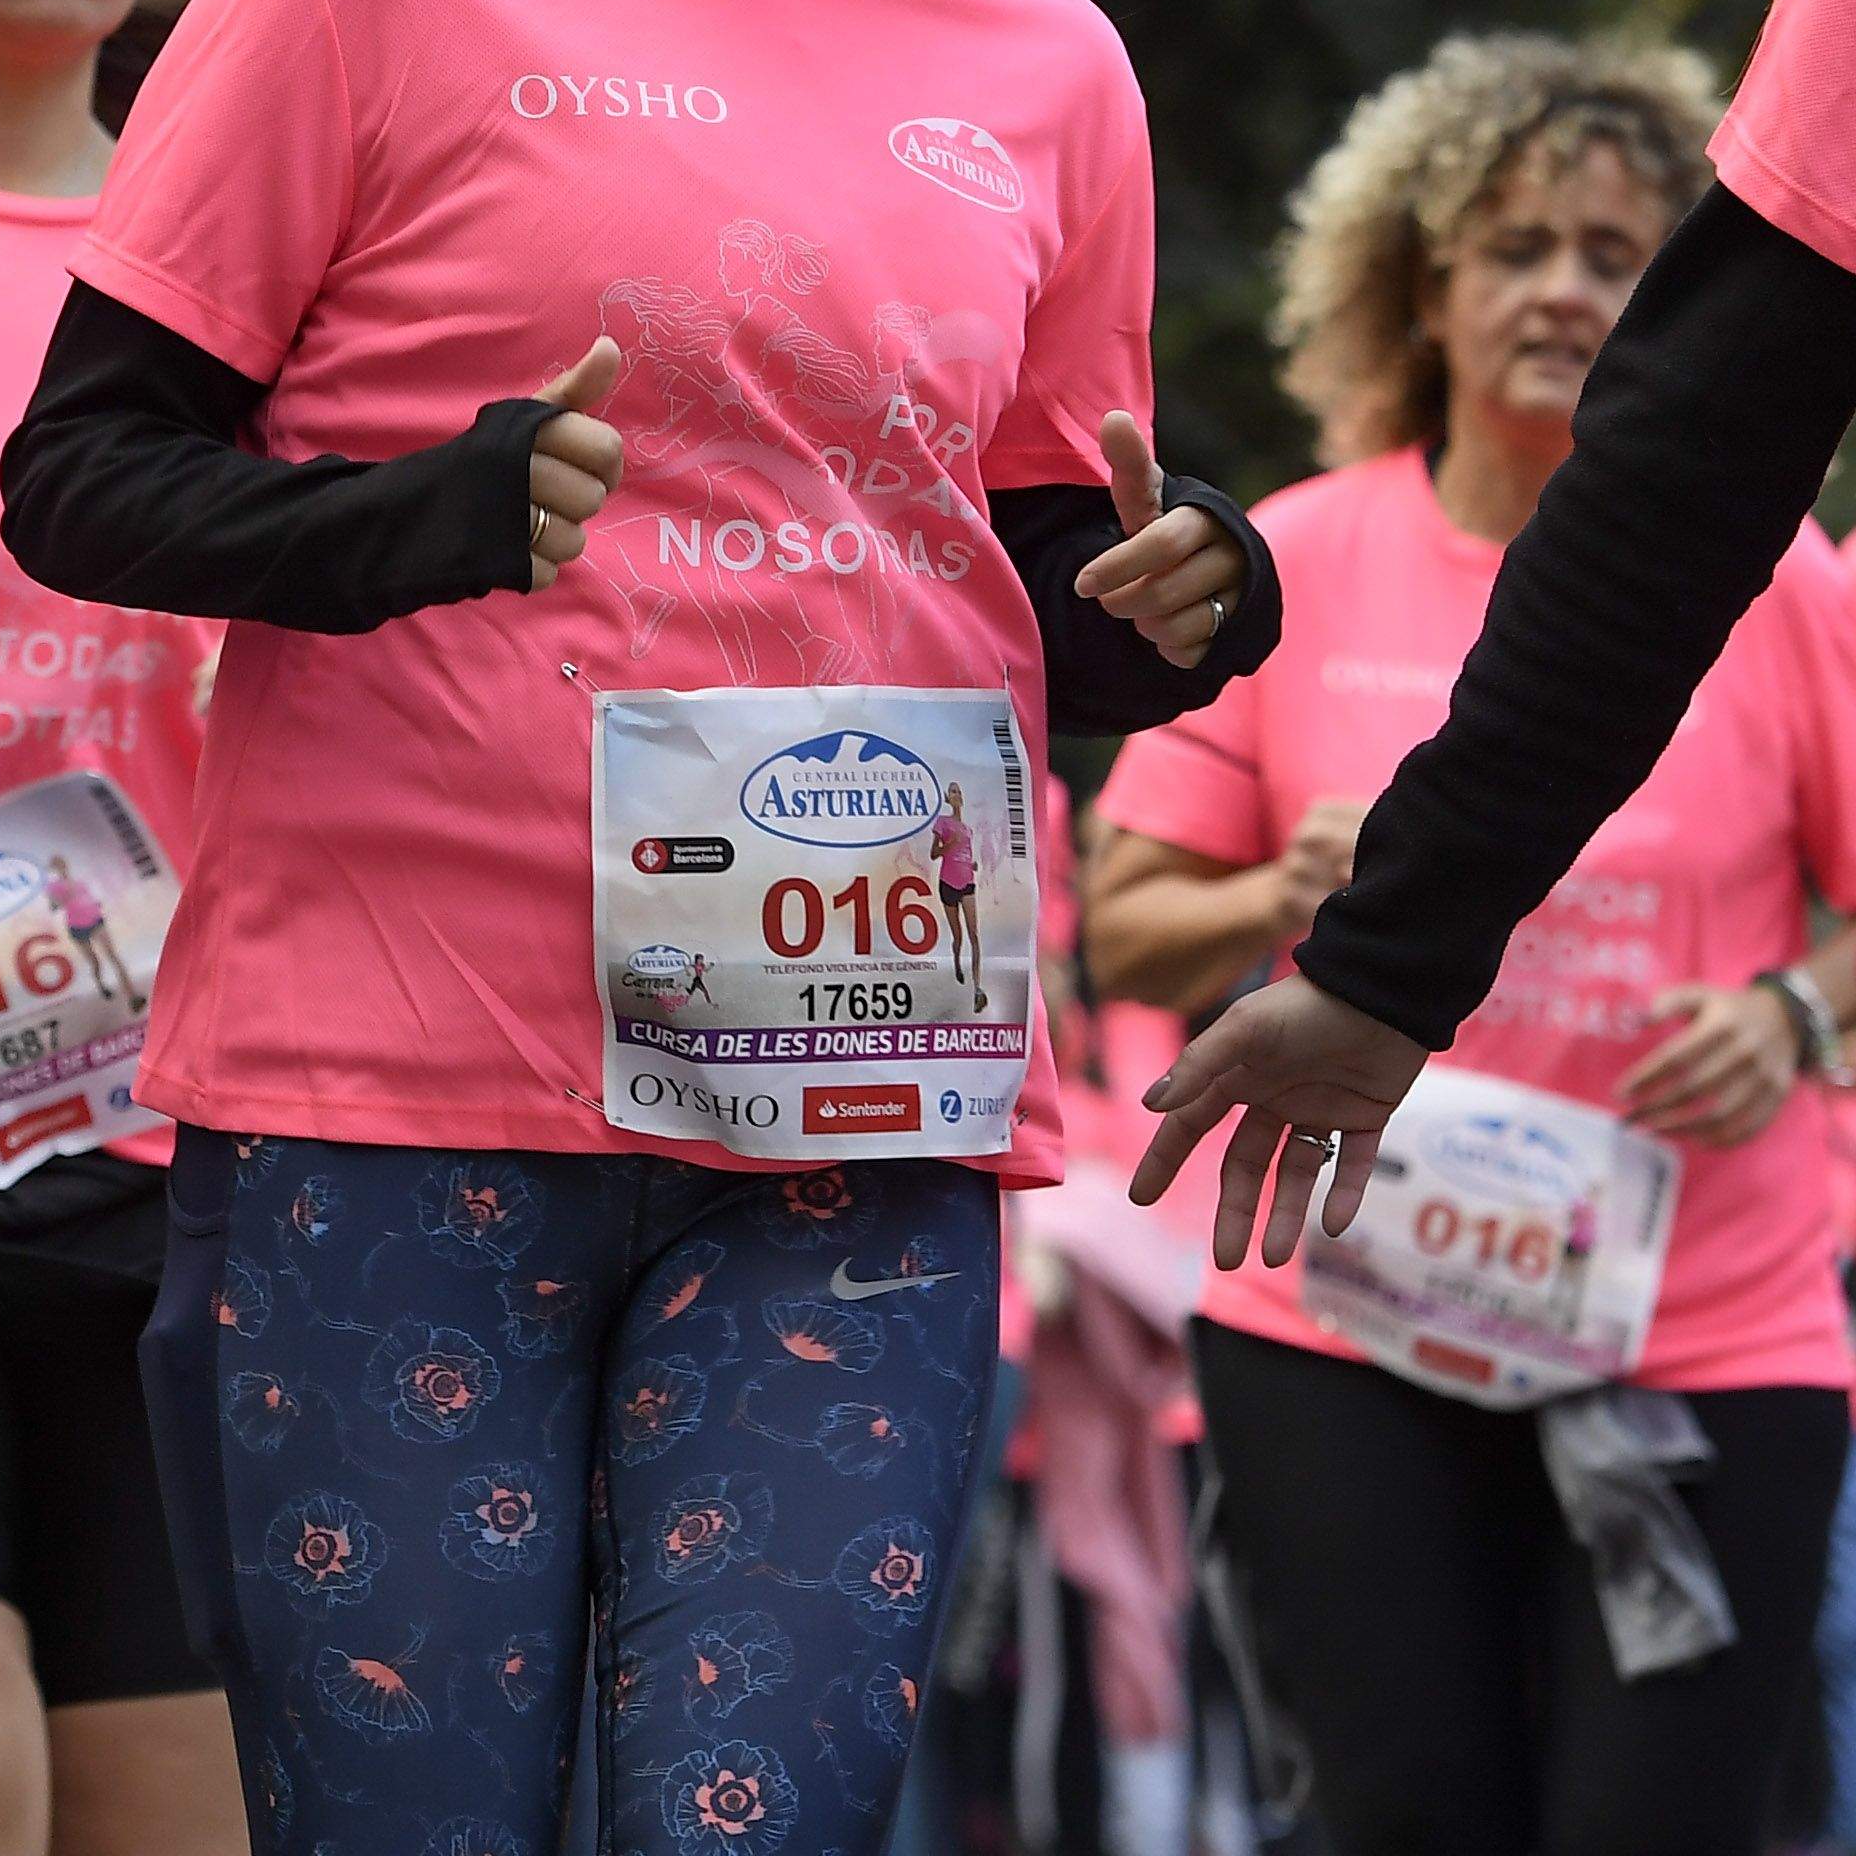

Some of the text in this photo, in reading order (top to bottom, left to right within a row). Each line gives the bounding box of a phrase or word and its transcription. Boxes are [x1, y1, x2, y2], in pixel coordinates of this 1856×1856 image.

[510, 73, 729, 125] OYSHO
[903, 133, 1018, 204] ASTURIANA
[819, 444, 977, 521] ODA
[758, 773, 930, 819] ASTURIANA
[792, 770, 923, 784] CENTRAL LECHERA
[673, 853, 724, 864] Barcelona
[760, 875, 940, 959] 016
[799, 981, 913, 1022] 17659
[629, 1020, 1024, 1059] CURSA DE LES DONES DE BARCELONA
[629, 1072, 780, 1129] OYSHO
[837, 1098, 908, 1119] Santander
[1414, 1195, 1552, 1283] 016
